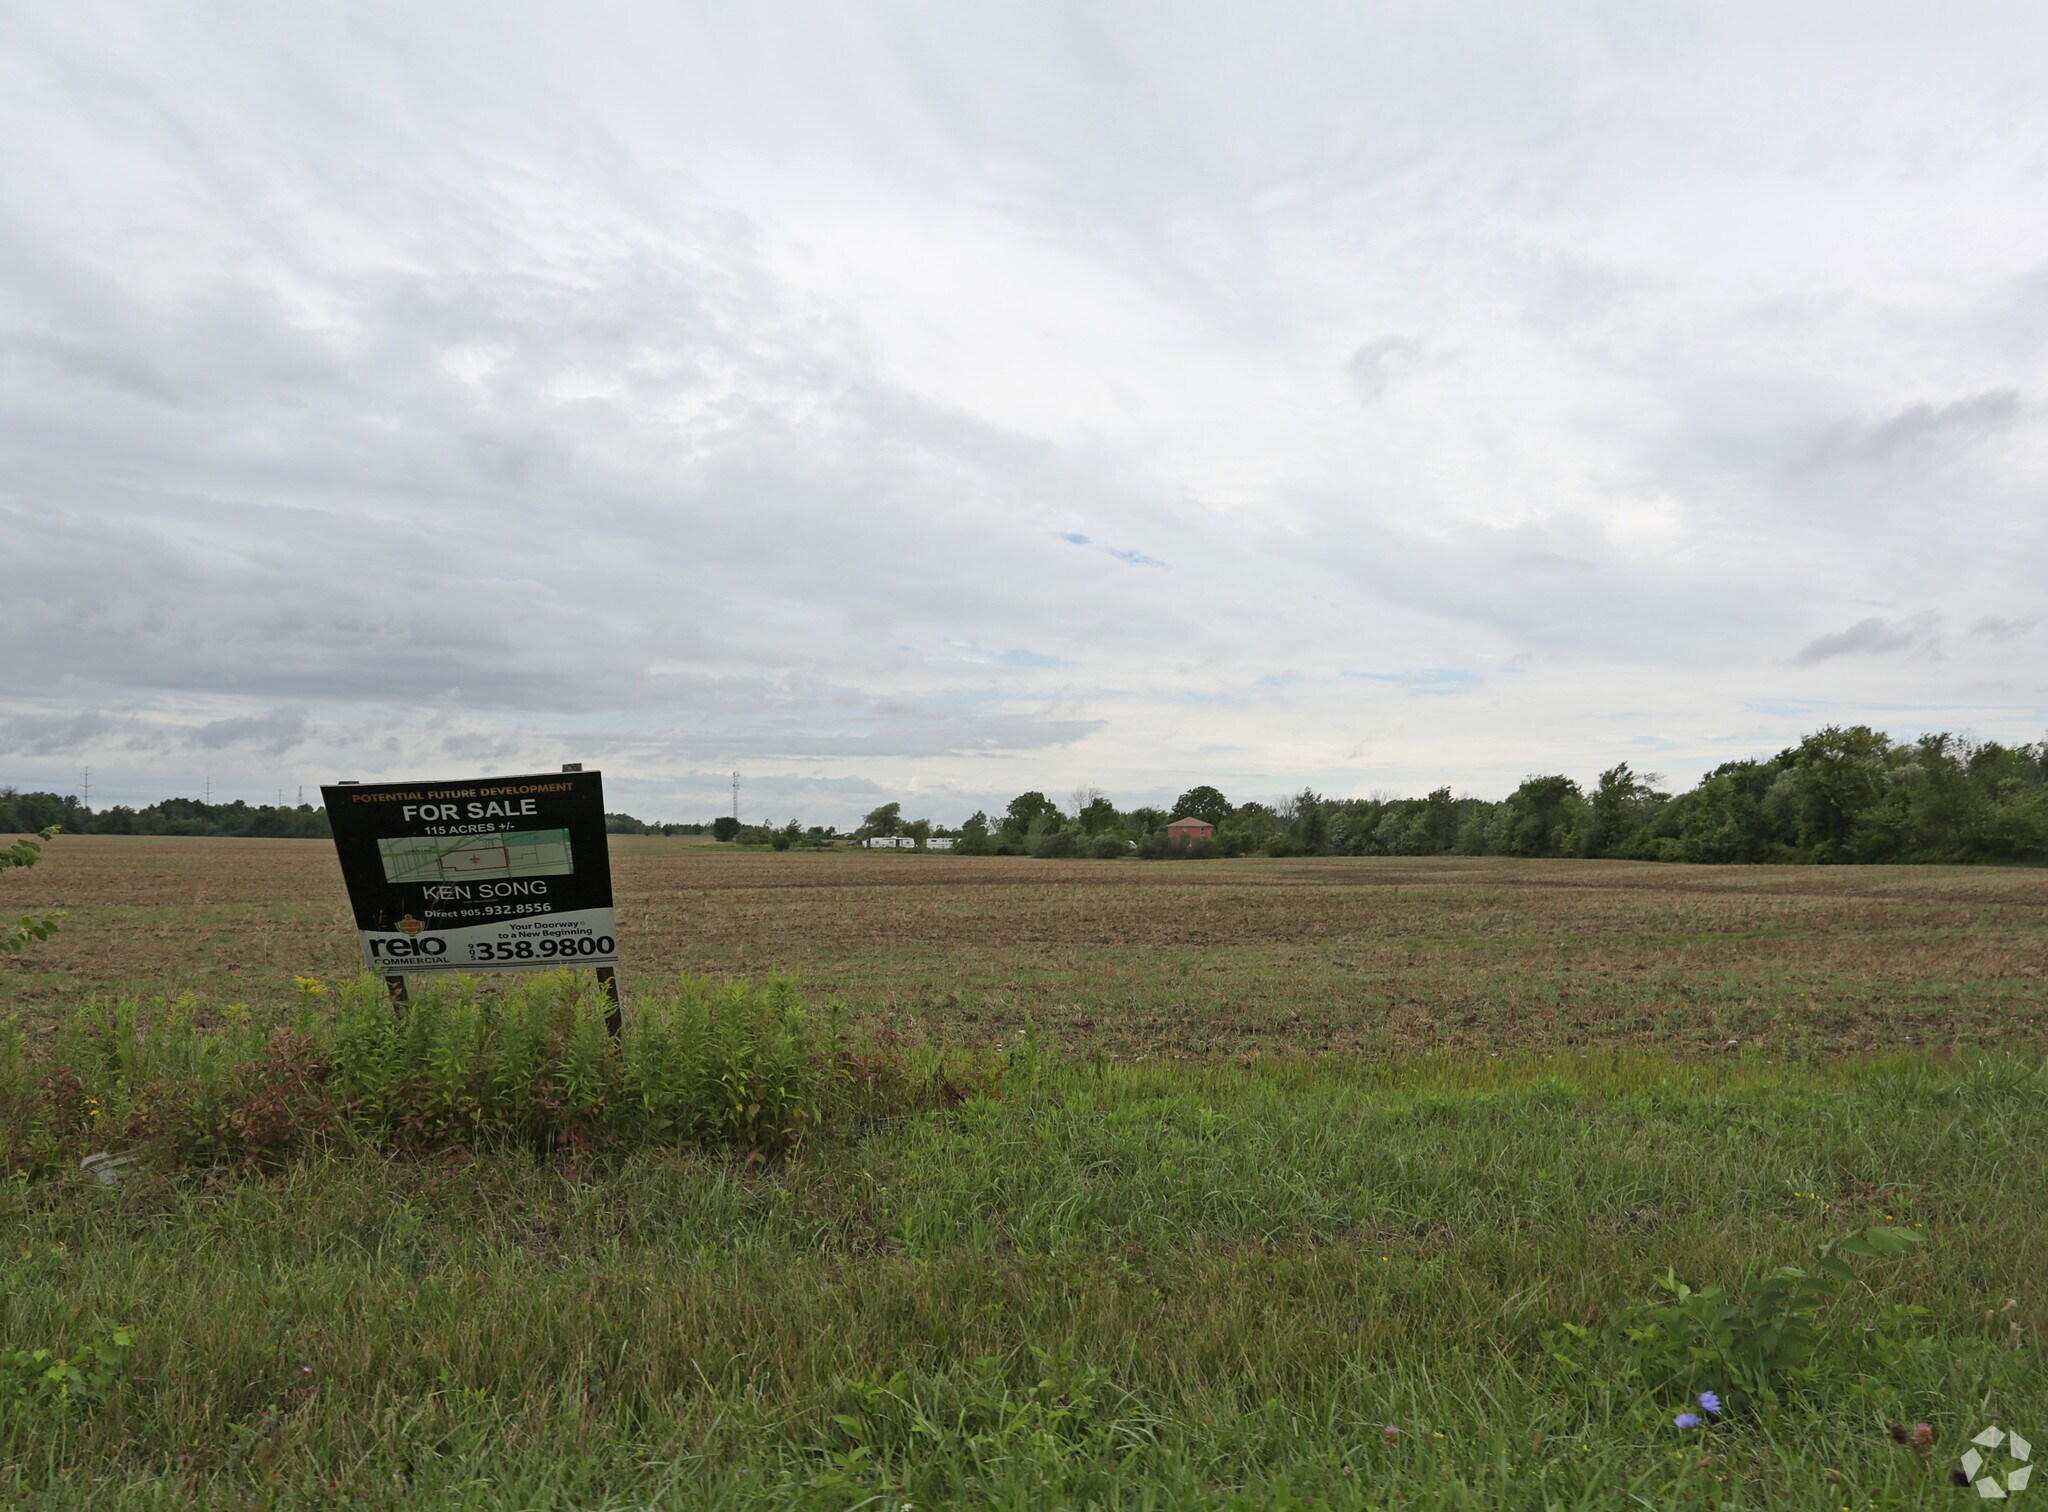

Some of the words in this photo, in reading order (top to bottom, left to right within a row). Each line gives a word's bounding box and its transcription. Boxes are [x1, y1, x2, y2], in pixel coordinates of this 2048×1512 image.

[352, 792, 424, 803] POTENTIAL
[427, 788, 477, 800] FUTURE
[480, 782, 574, 796] DEVELOPMENT
[402, 804, 460, 821] FOR
[467, 799, 538, 820] SALE
[424, 825, 446, 835] 115
[449, 823, 496, 834] ACRES
[422, 885, 471, 899] KEN
[479, 880, 547, 898] SONG
[424, 909, 458, 918] Direct
[460, 902, 551, 917] 905.932.8556
[509, 922, 532, 931] Your
[534, 921, 579, 930] Doorway
[542, 928, 593, 938] Beginning
[475, 935, 615, 961] 358.9800
[374, 957, 450, 966] COMMERCIAL
